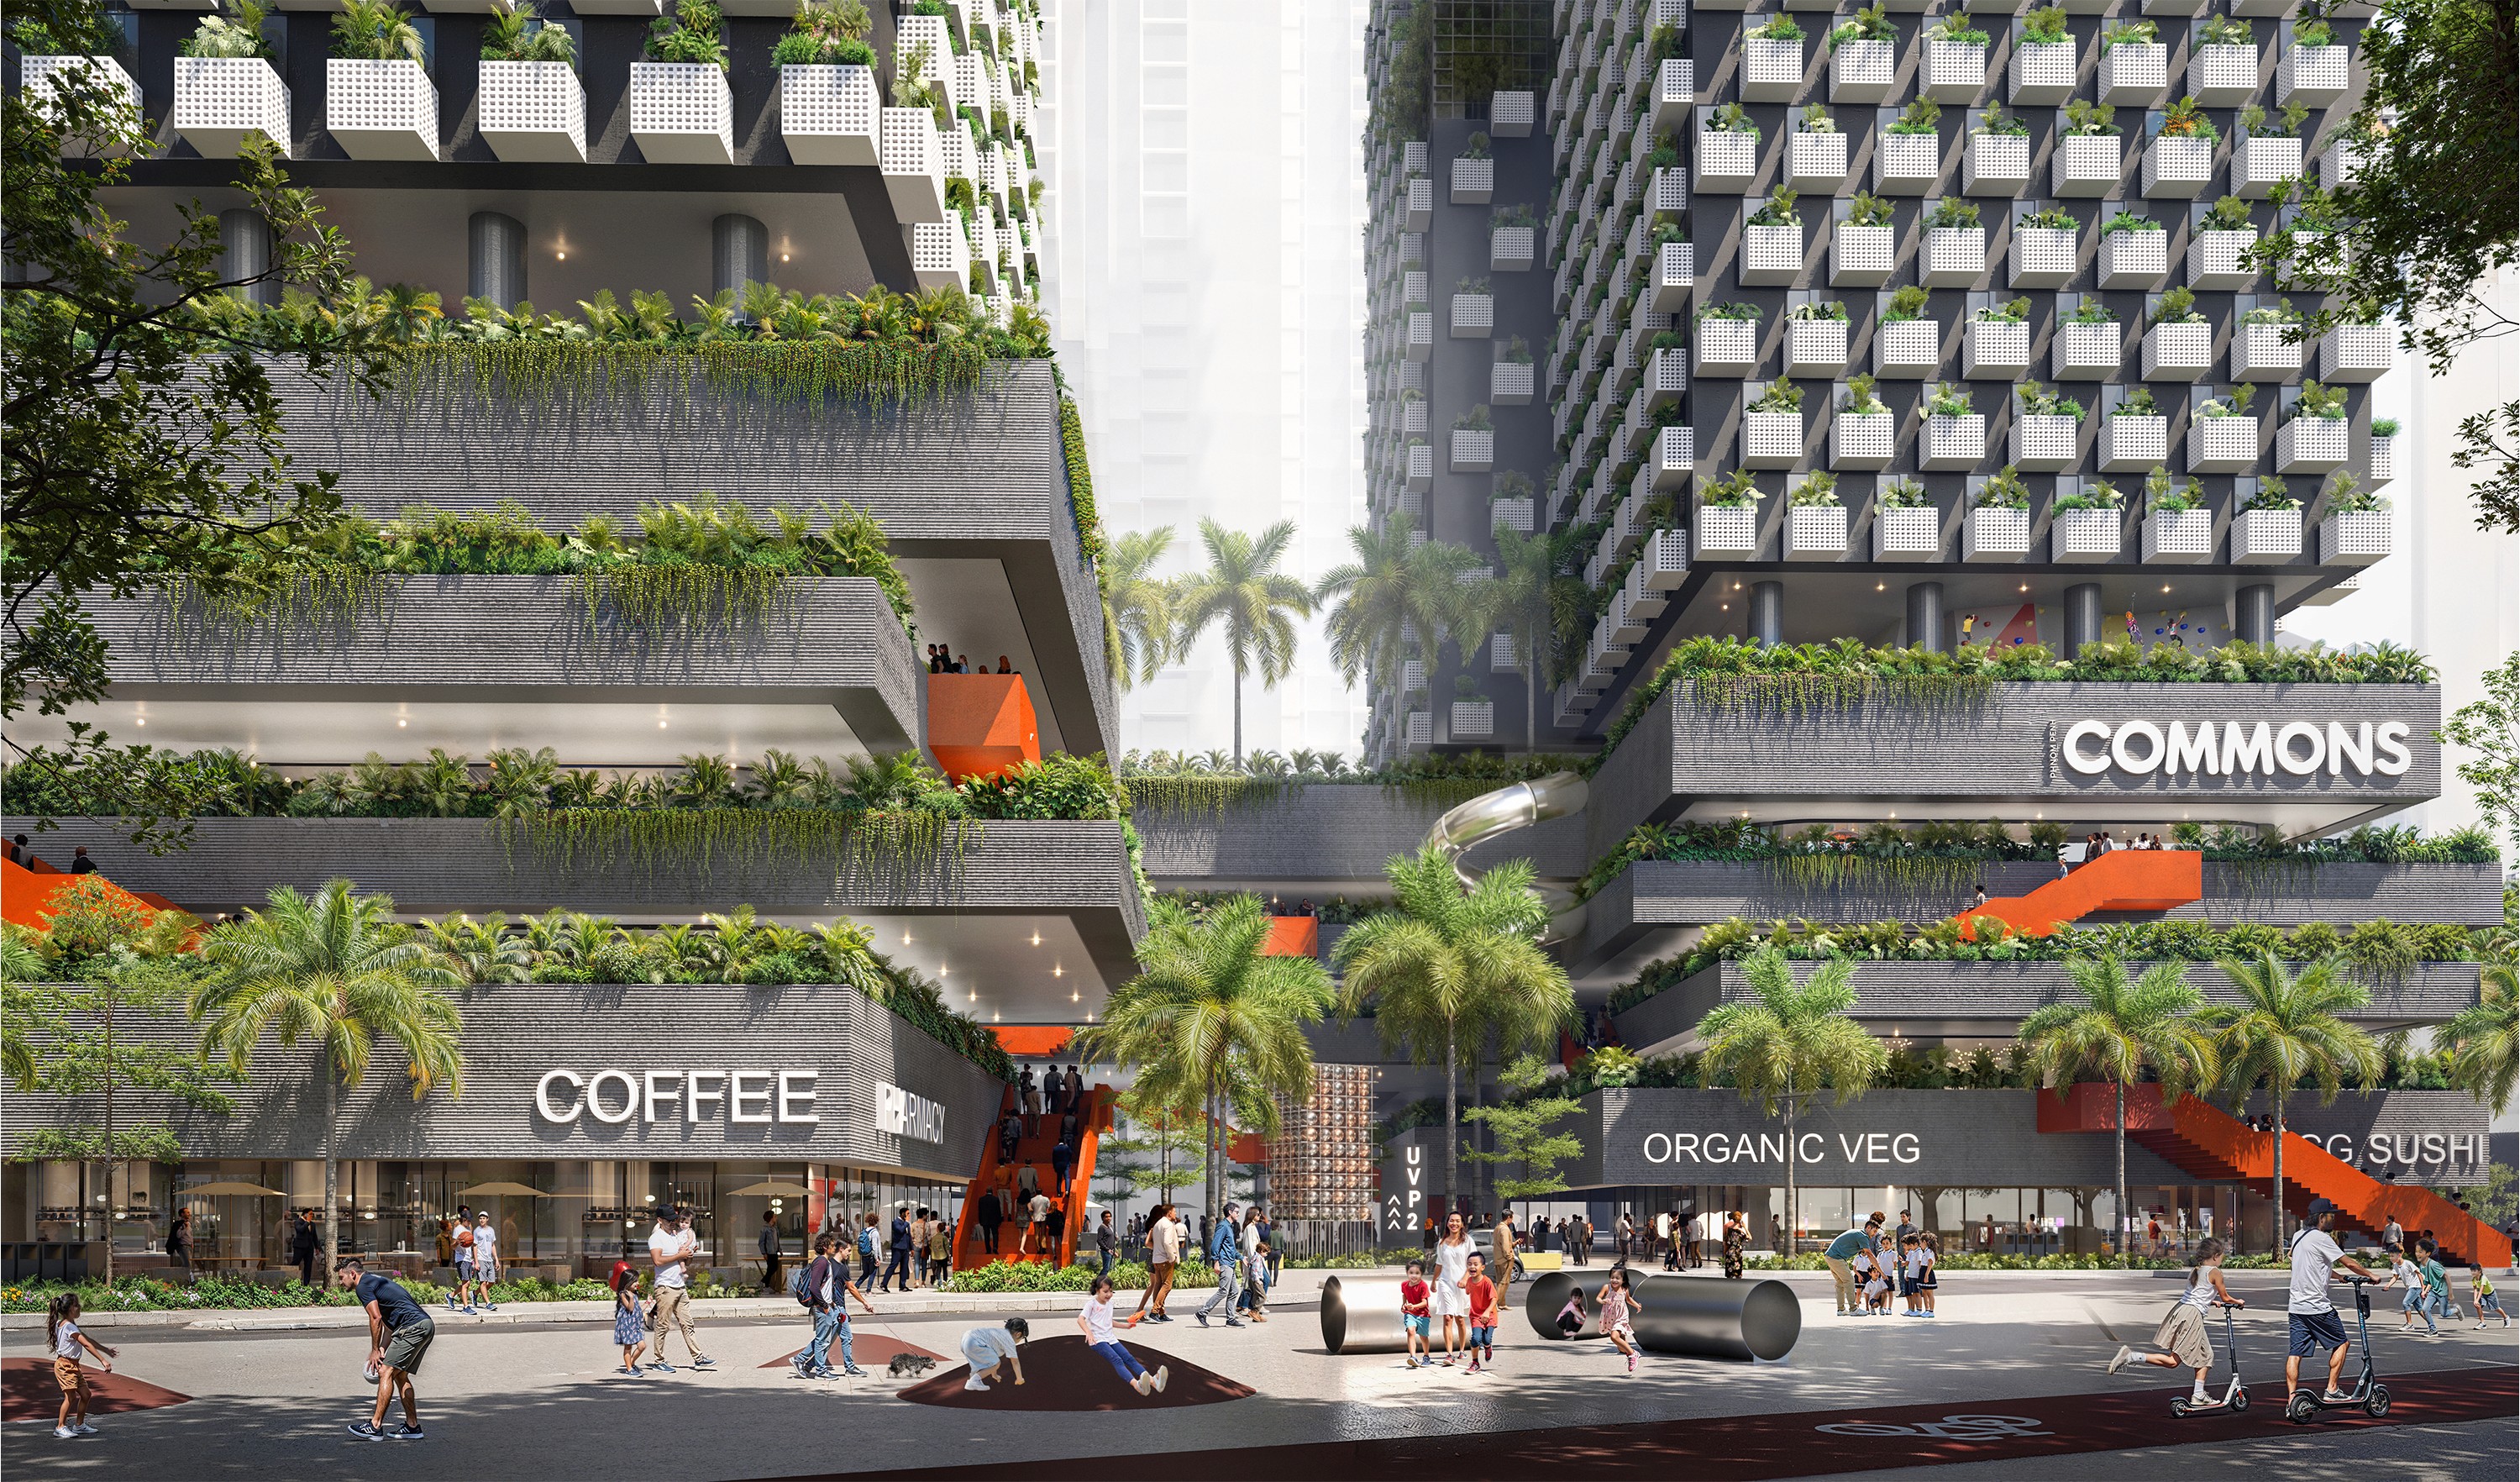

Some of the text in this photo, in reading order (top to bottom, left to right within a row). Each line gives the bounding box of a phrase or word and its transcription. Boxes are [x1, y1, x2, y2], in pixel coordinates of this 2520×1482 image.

[2063, 719, 2412, 775] COMMONS
[536, 1069, 820, 1123] COFFEE
[1839, 1133, 1921, 1164] VEG
[2368, 1133, 2484, 1164] SUSHI
